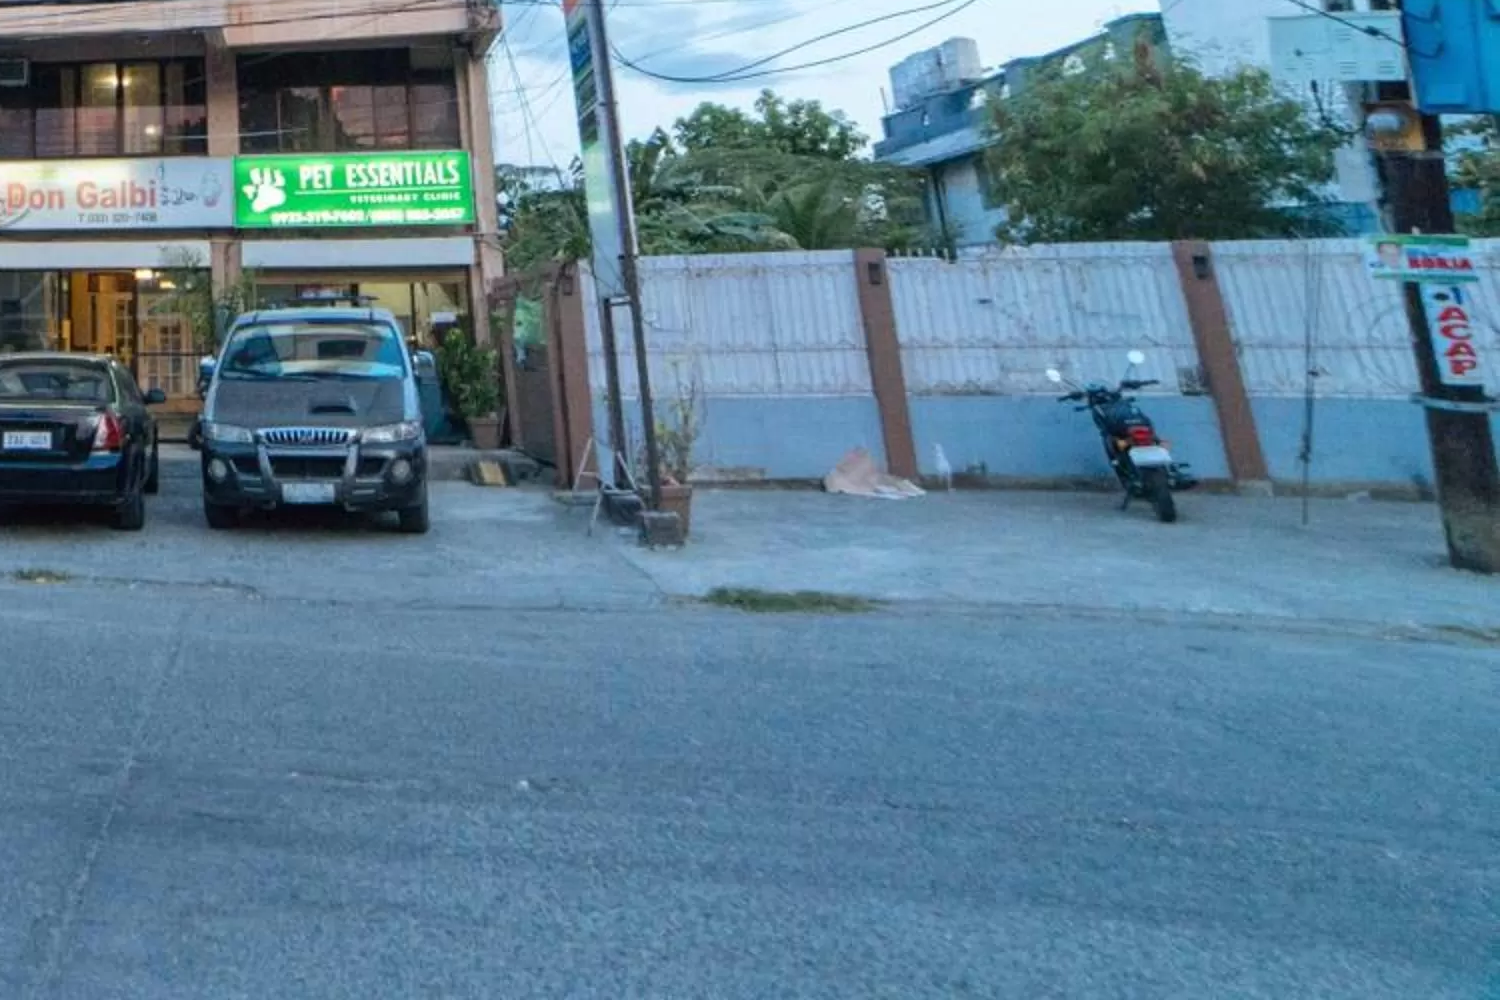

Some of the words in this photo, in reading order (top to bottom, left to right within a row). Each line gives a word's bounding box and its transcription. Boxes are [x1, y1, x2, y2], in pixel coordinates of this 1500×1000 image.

[299, 163, 335, 189] PET
[345, 159, 461, 188] ESSENTIALS
[6, 182, 65, 210] Don
[76, 179, 157, 210] Galbi
[423, 191, 462, 201] CLINIC
